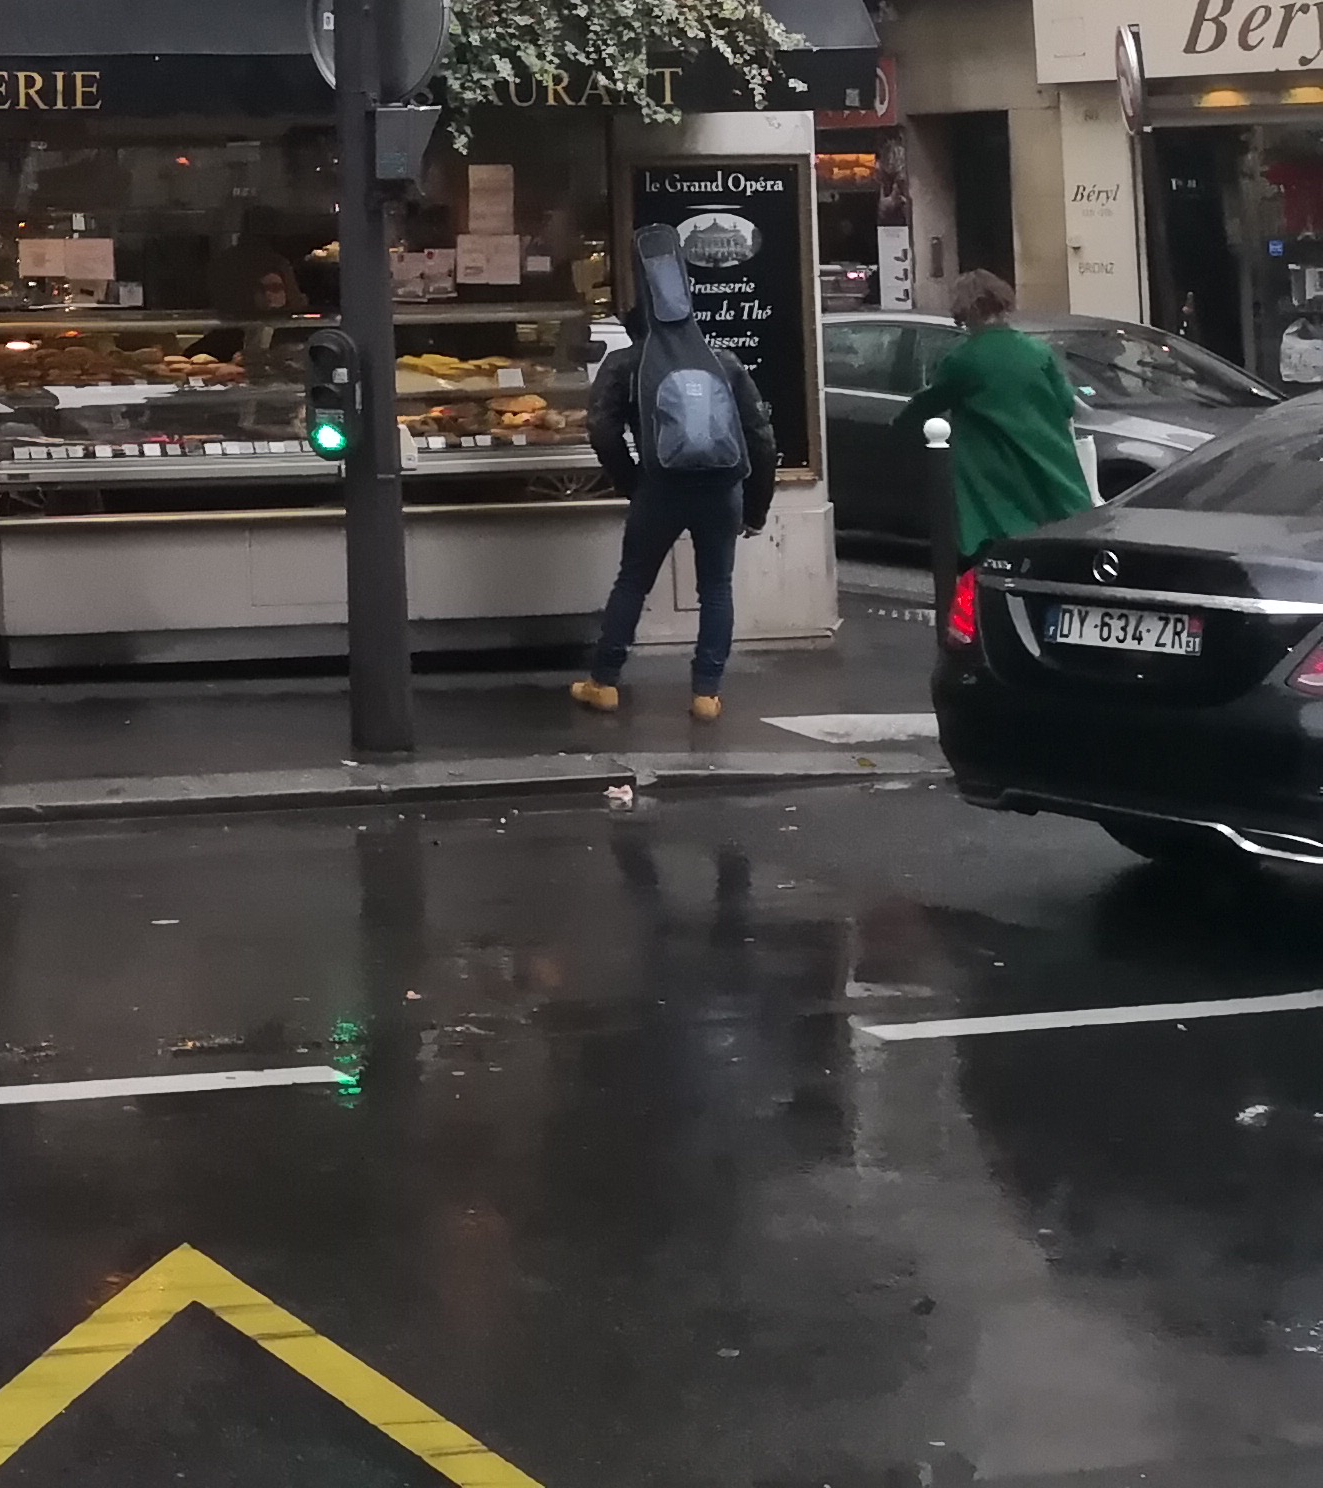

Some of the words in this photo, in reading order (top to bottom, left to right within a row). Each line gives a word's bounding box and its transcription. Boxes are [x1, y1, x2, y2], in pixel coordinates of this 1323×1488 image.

[646, 171, 661, 192] le
[665, 170, 724, 193] Grand
[728, 172, 784, 196] Opéra
[1071, 184, 1120, 207] Béryl
[715, 300, 736, 321] de
[704, 330, 761, 349] tisserie
